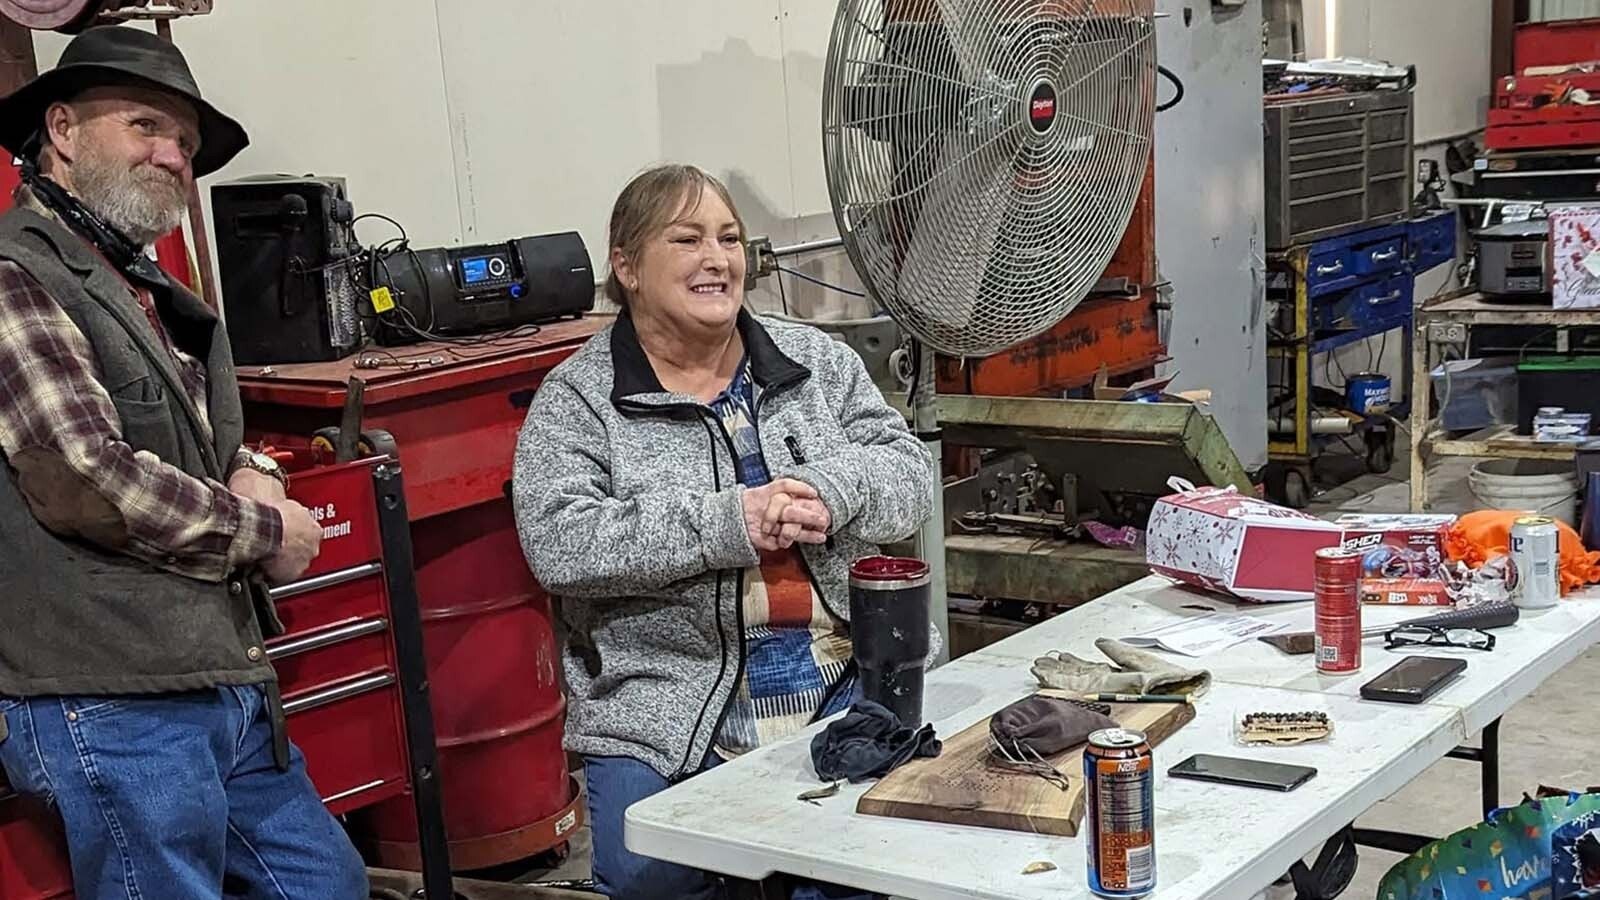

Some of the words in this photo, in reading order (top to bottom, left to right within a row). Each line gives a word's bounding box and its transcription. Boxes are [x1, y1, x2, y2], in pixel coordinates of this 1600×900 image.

[309, 506, 325, 521] ols
[326, 503, 336, 519] &
[323, 520, 351, 539] ment
